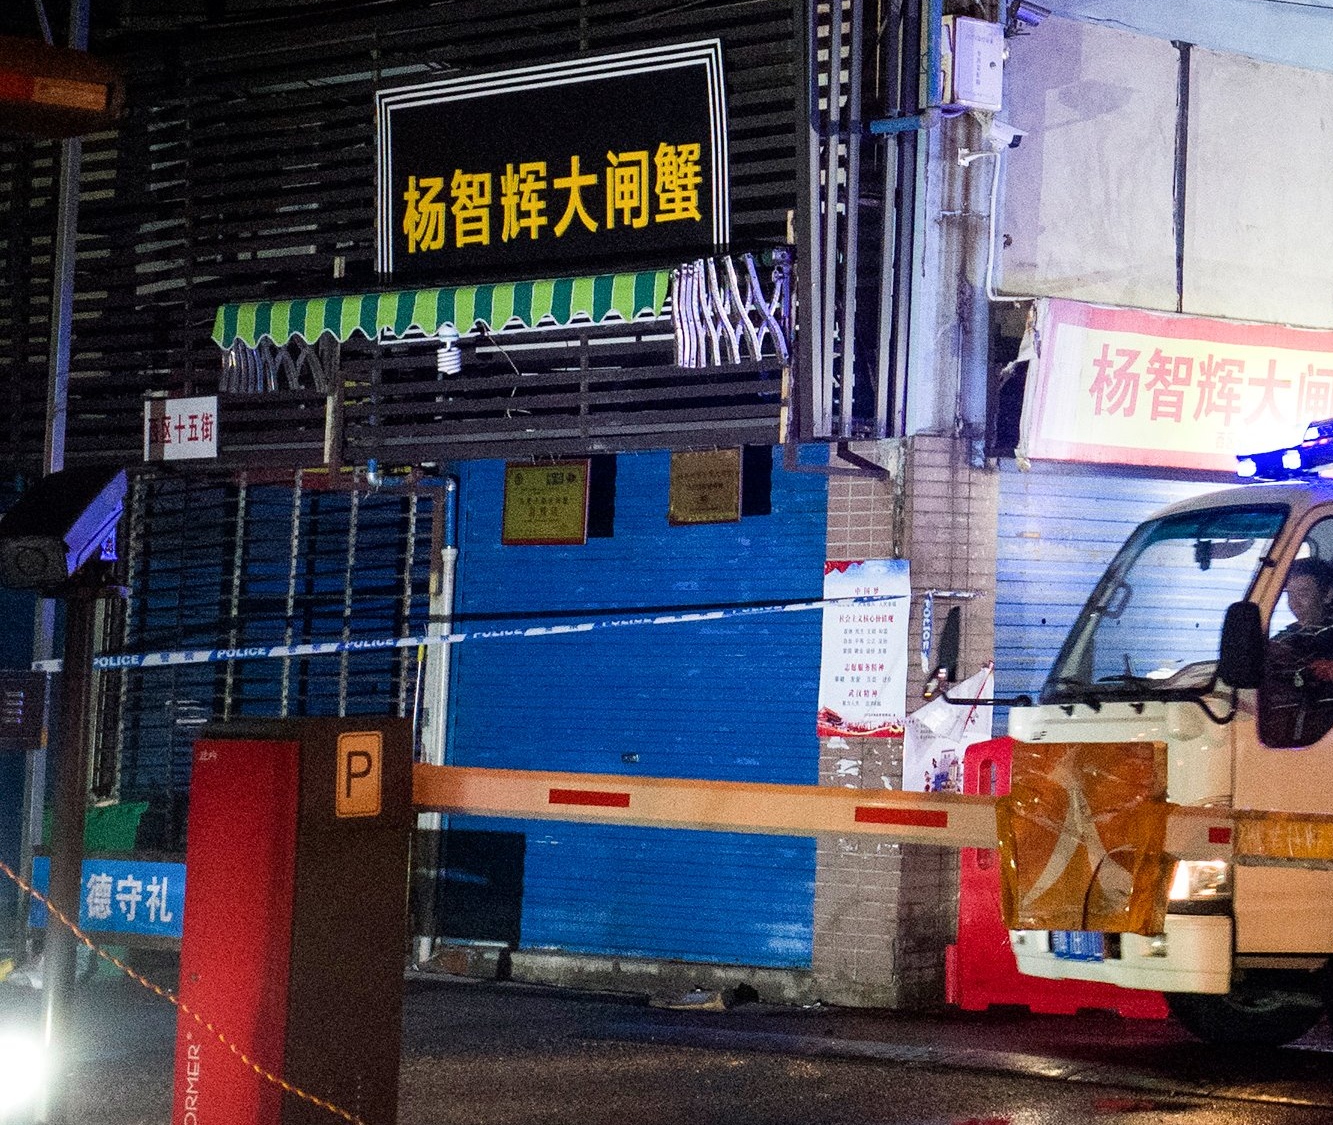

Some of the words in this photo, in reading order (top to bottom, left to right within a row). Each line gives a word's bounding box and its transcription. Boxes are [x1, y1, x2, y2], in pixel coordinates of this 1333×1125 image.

[402, 142, 703, 254] 杨智辉大闸蟹
[216, 647, 267, 659] POLICE
[345, 751, 373, 799] P
[86, 872, 173, 923] 德守礼
